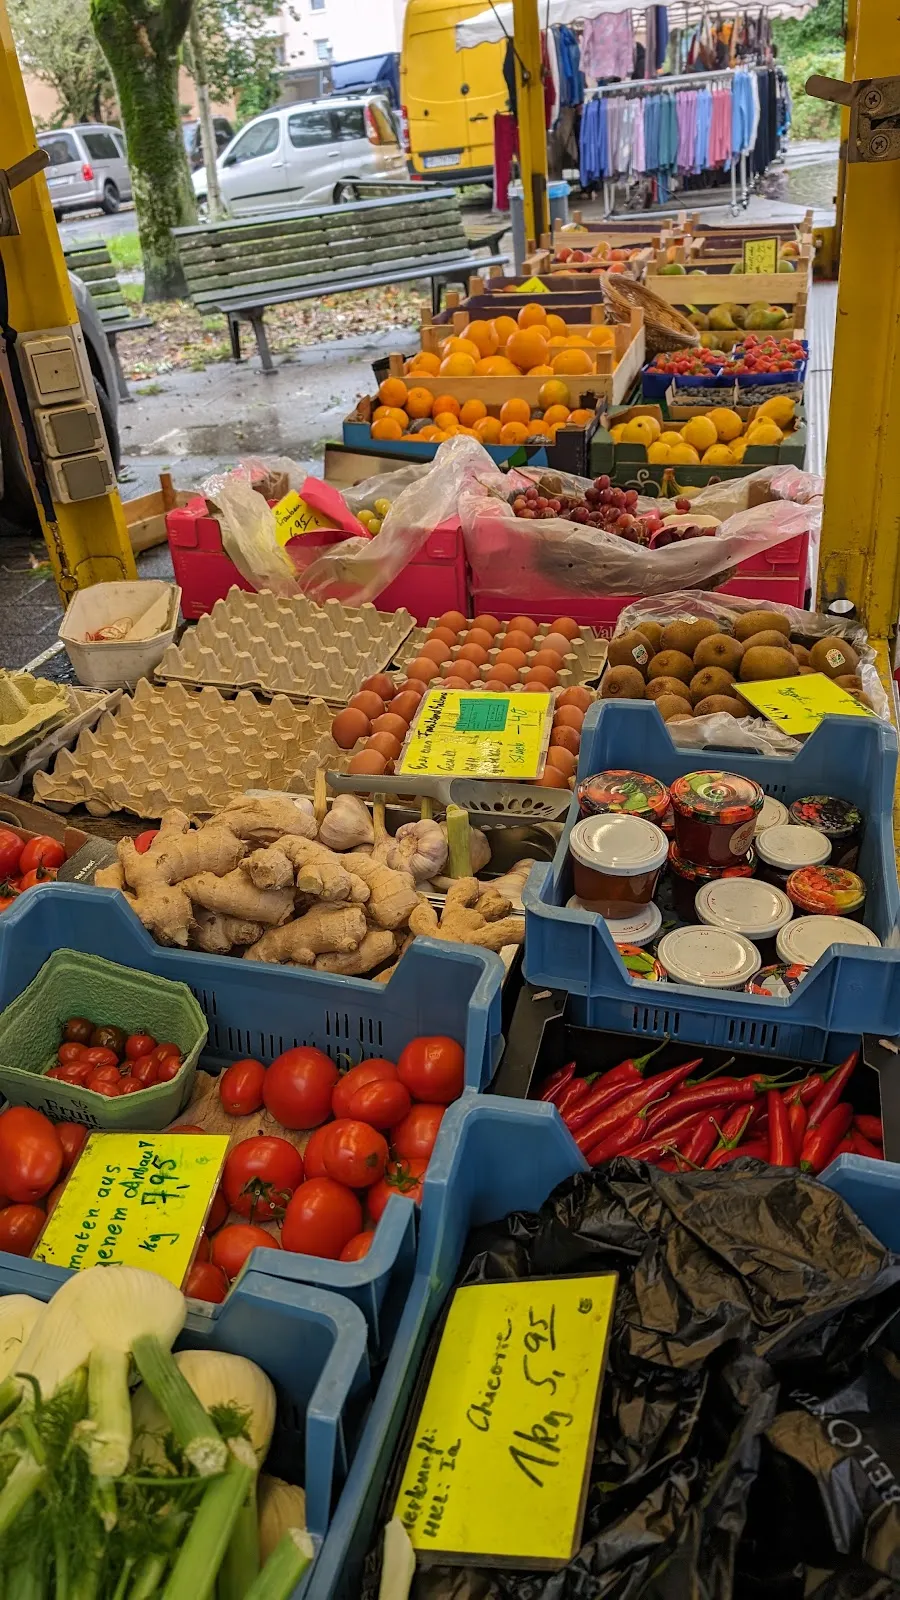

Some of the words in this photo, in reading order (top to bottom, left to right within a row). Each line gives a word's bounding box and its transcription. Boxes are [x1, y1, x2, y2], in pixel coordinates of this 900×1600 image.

[44, 1098, 101, 1126] Fruit
[67, 1208, 101, 1270] maten
[97, 1164, 121, 1198] aus
[94, 1207, 128, 1267] genem
[522, 1304, 566, 1396] 5,95
[788, 1388, 900, 1506] BELOTA
